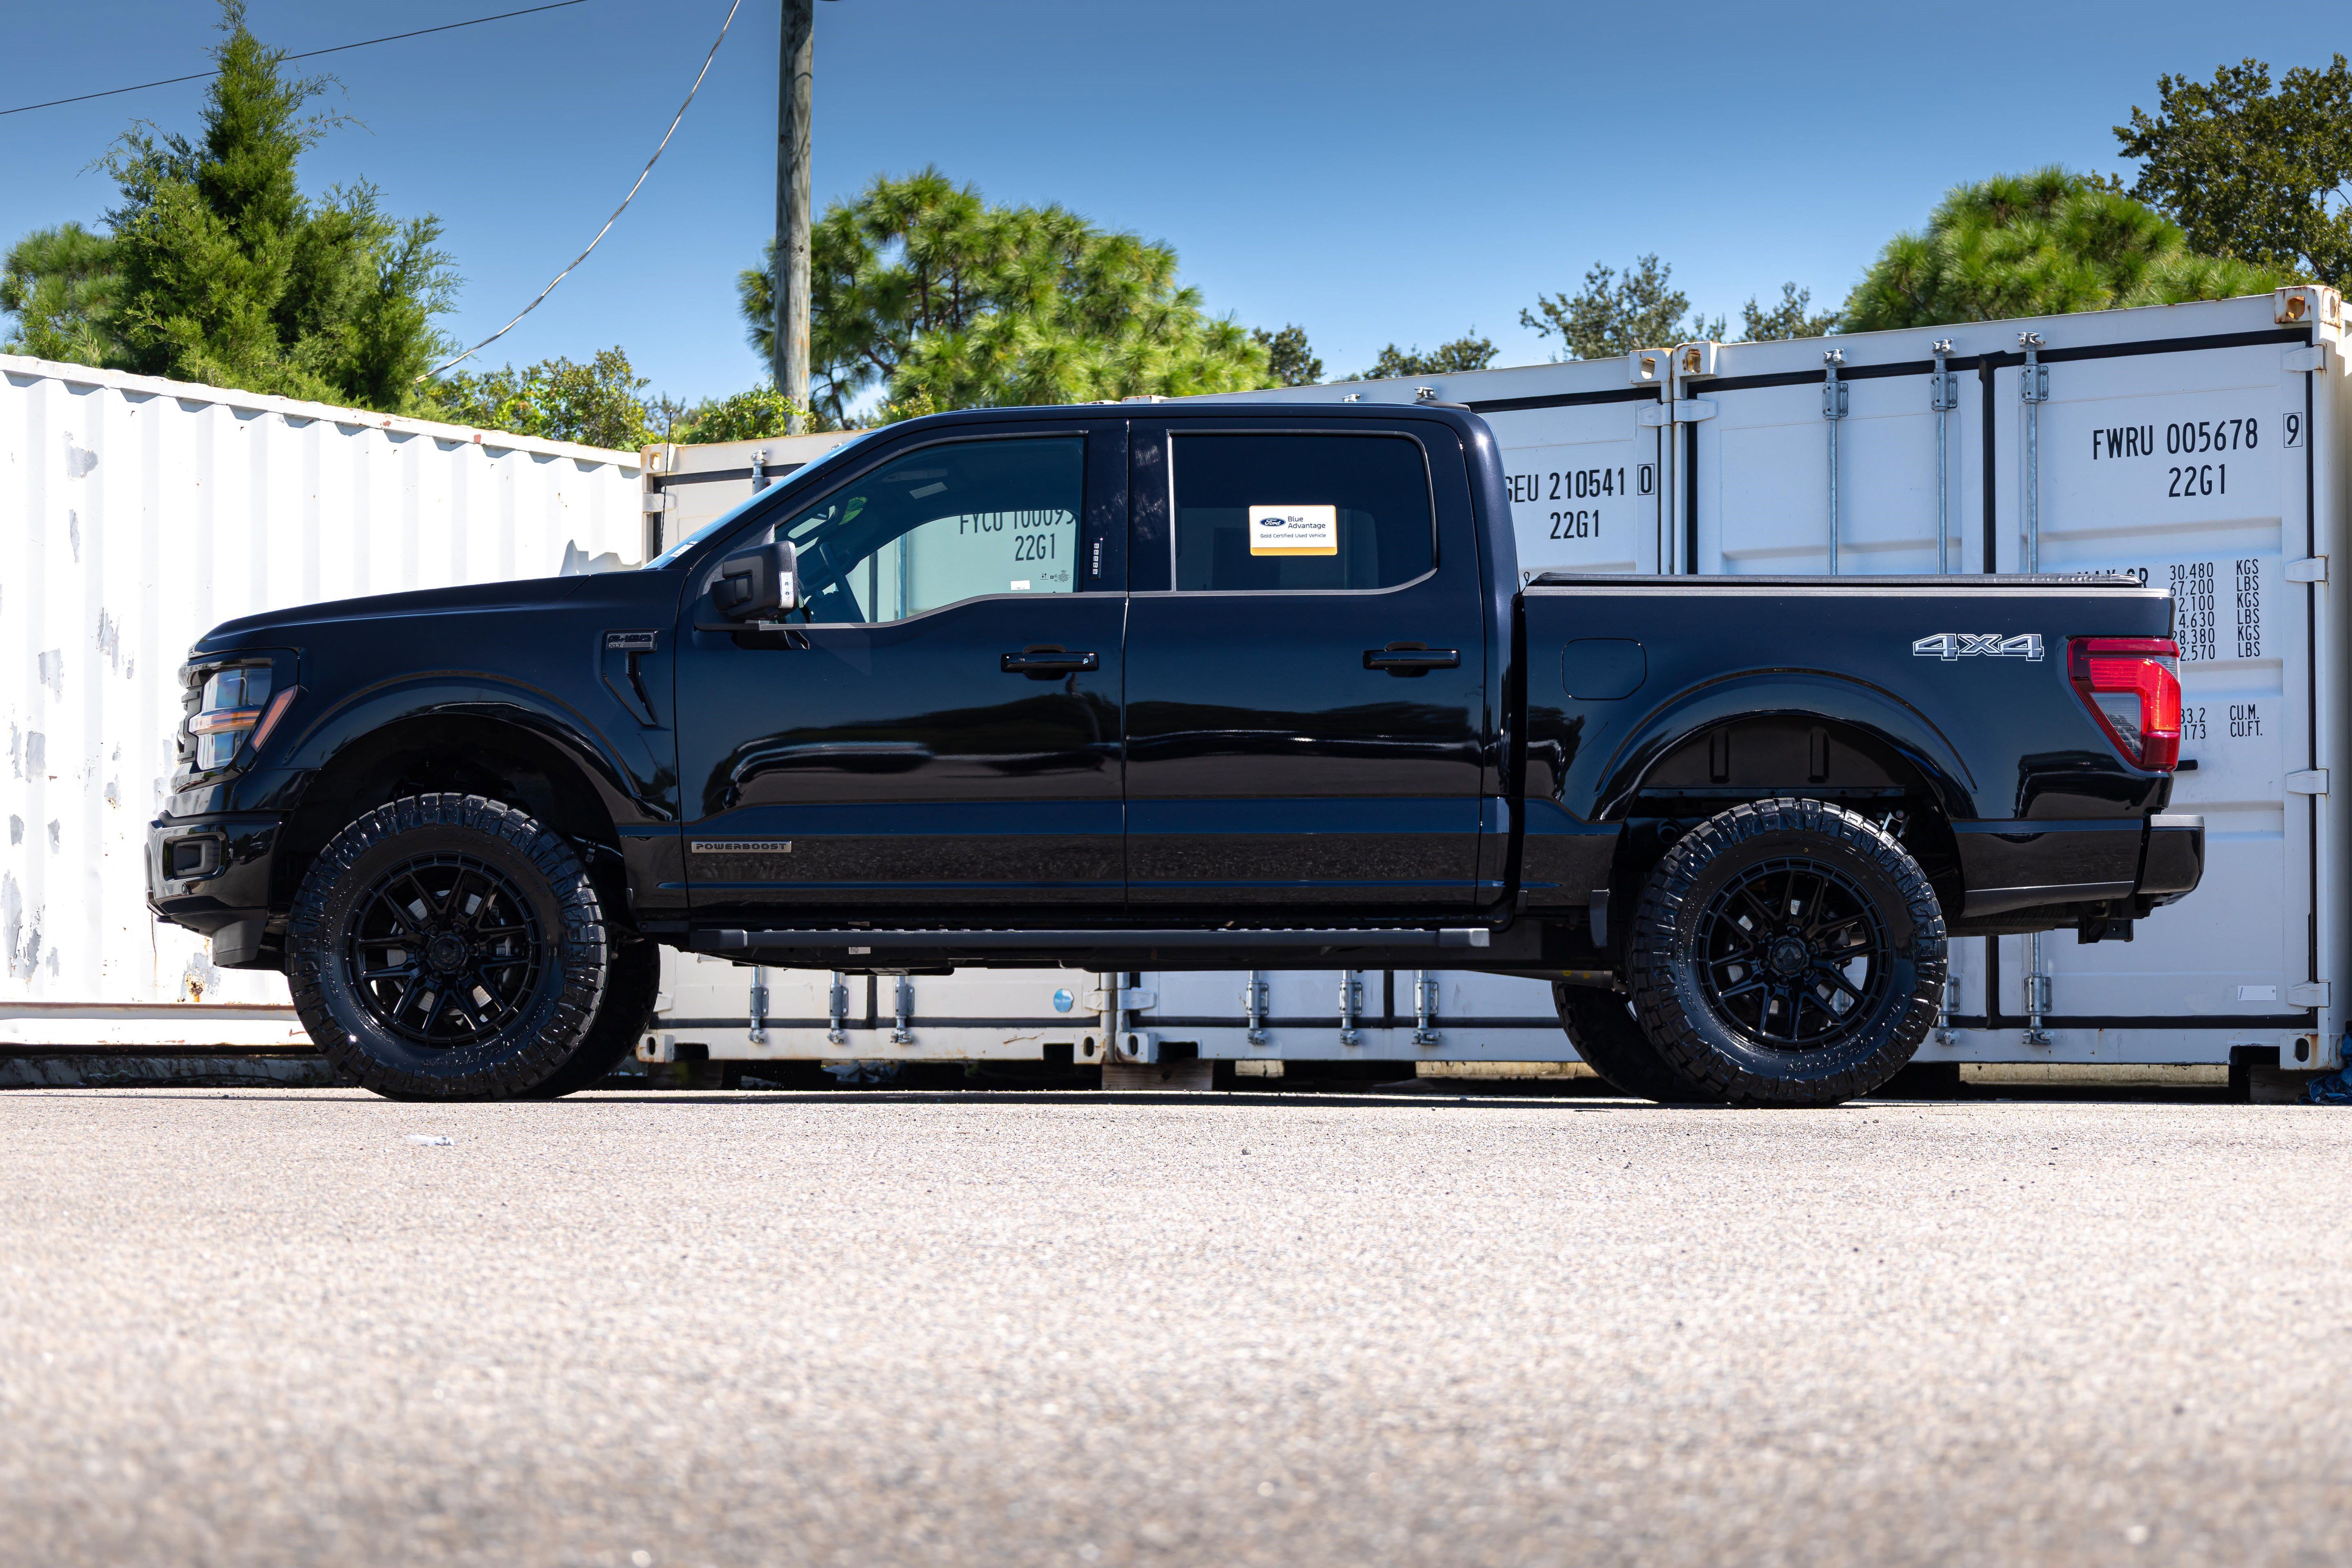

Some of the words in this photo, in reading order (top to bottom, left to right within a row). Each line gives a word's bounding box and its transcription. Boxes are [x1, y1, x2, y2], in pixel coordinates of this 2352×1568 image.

[2094, 425, 2154, 460] FWRU
[2167, 418, 2258, 454] 005678
[2287, 414, 2300, 446] 9
[1550, 467, 1625, 500] 210541
[2169, 464, 2225, 497] 22G1
[1550, 510, 1599, 539] 22G1
[1015, 533, 1055, 561] 22G1
[2169, 562, 2214, 580] 30,480
[2236, 559, 2258, 575] KGS
[2170, 578, 2214, 597] 67,200
[2236, 575, 2259, 592] LBS
[2178, 595, 2214, 612] 2,100
[2237, 592, 2259, 608] KGS
[2178, 611, 2215, 628] 4,630
[2238, 608, 2260, 625] LBS
[2238, 624, 2260, 641] KGS
[2238, 641, 2261, 658] LBS
